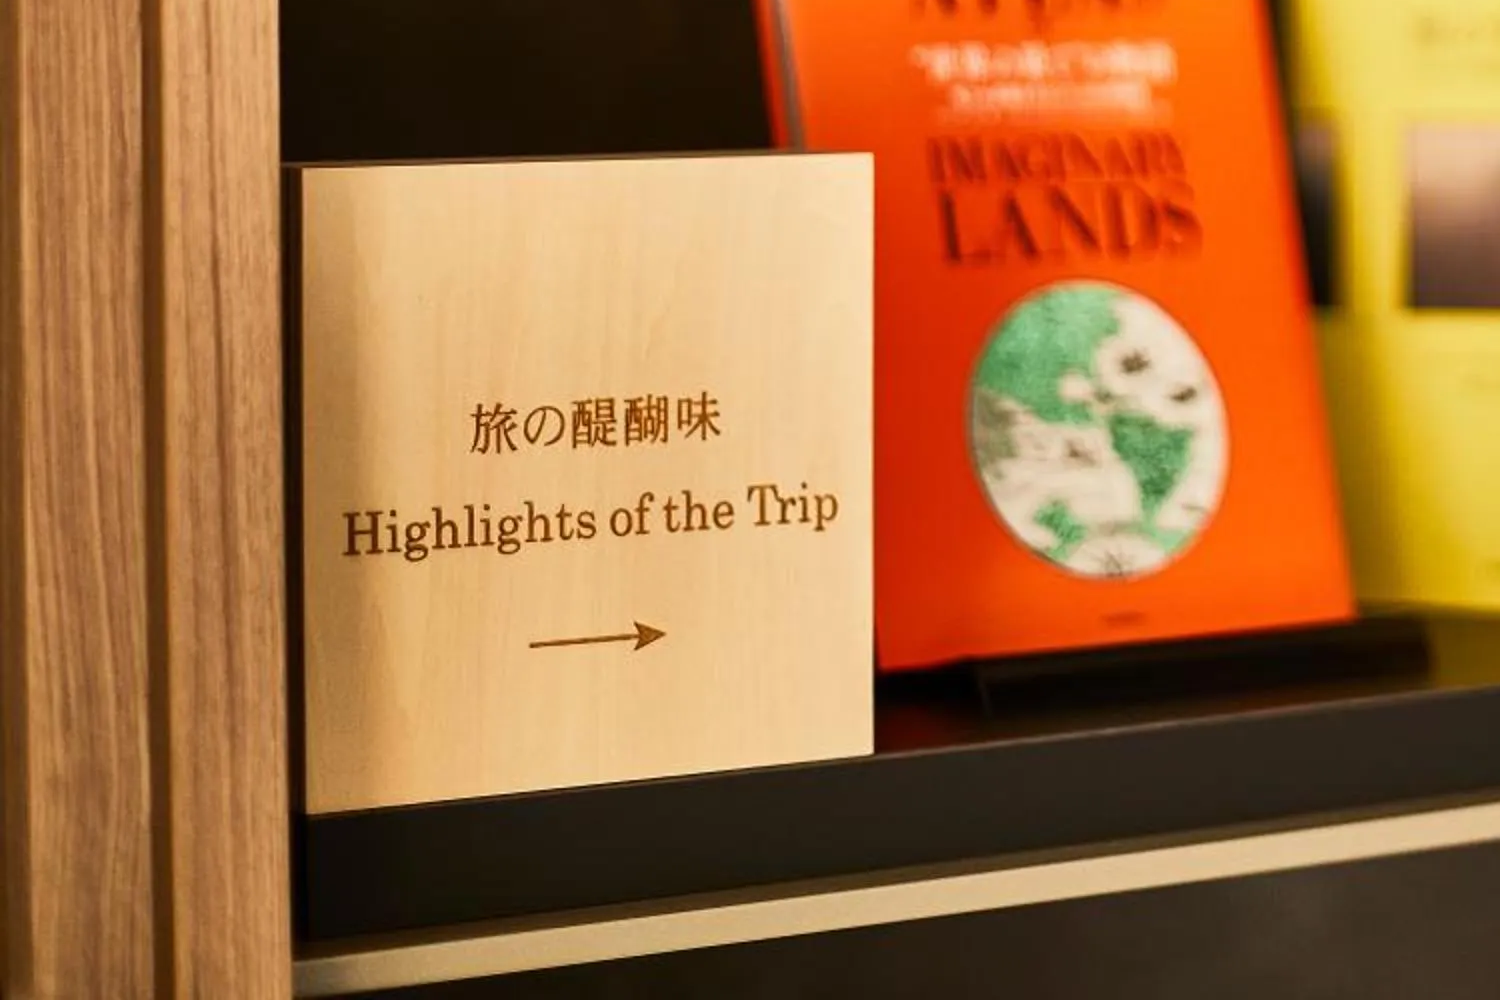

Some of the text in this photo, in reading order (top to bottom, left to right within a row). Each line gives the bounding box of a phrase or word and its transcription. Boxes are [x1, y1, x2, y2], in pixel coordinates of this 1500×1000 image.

[940, 181, 1203, 262] LANDS
[470, 391, 721, 454] 旅の醍醐味
[342, 482, 839, 563] Highlights of the Trip
